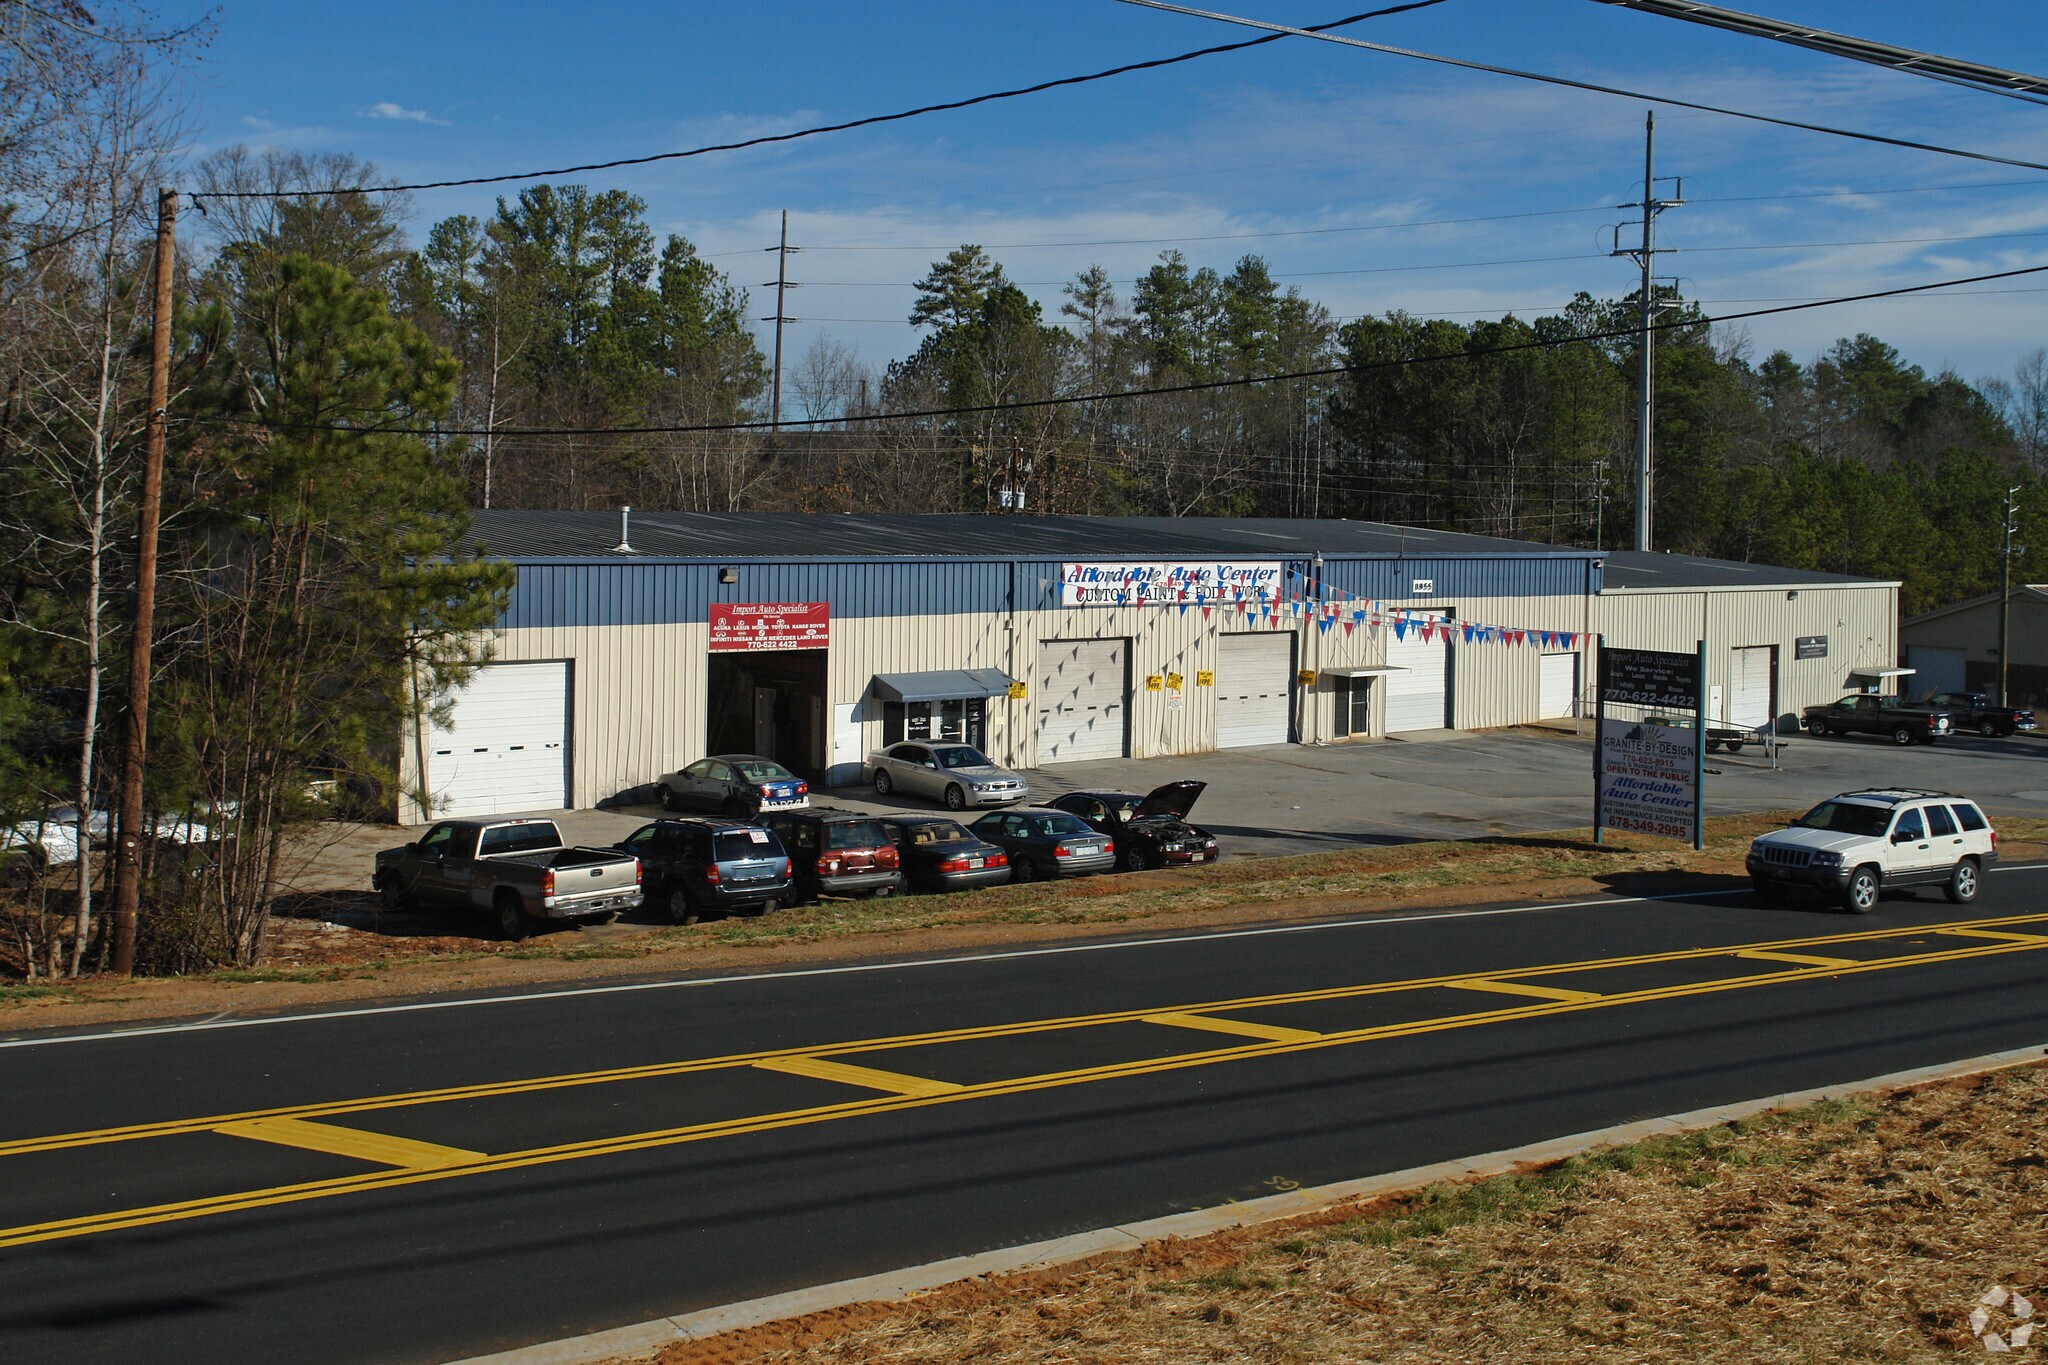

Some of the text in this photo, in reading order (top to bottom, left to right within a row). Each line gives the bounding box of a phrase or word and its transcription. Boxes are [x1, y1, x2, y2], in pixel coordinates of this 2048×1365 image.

[1169, 566, 1211, 581] Auto
[1218, 565, 1278, 581] Center
[732, 604, 808, 615] Import Auto Specialist
[1607, 651, 1690, 667] Import Auto Specialist
[1640, 666, 1674, 675] Service:
[1604, 689, 1695, 707] 770-622-4422
[1622, 754, 1674, 768] 770-623-8915
[1606, 765, 1690, 782] OPEN TO THE PUBLIC
[1612, 777, 1683, 795] Affordable
[1601, 799, 1624, 807] CUSTOM
[1602, 787, 1694, 808] Auto Center
[1614, 809, 1653, 820] INSURANCE
[1655, 814, 1693, 826] ACCEPTED
[1608, 816, 1686, 837] 678-349-2995
